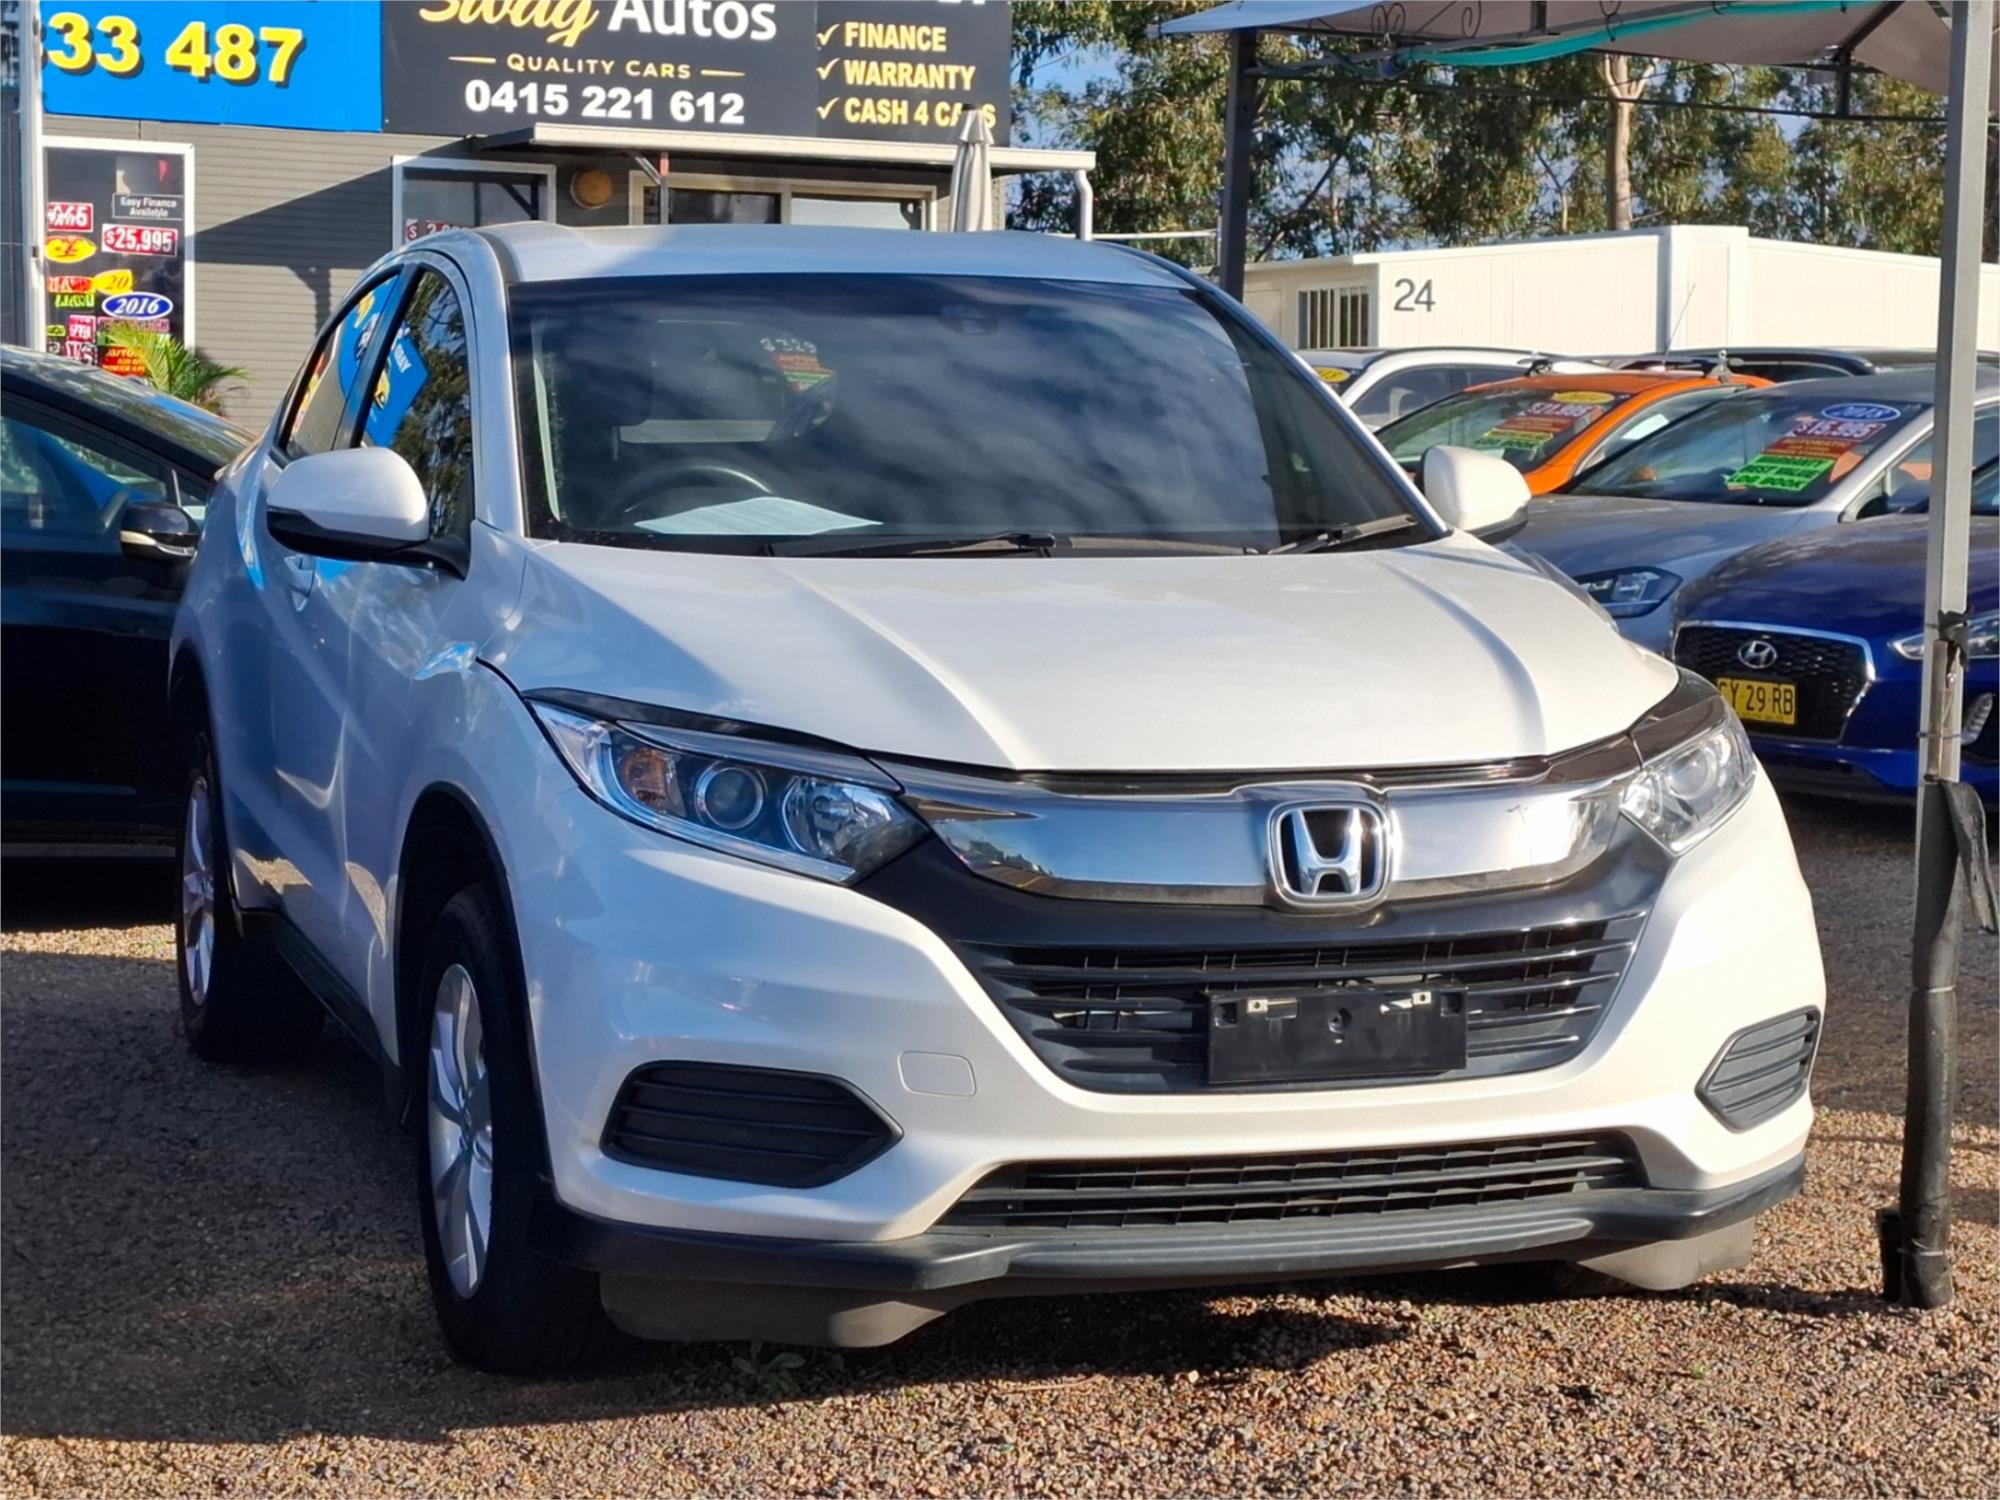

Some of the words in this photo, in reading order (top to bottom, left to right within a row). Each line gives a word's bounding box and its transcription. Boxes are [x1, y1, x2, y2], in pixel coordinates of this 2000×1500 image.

[607, 0, 777, 41] Autos
[165, 21, 303, 82] 487
[844, 21, 947, 52] FINANCE
[507, 53, 615, 75] QUALITY
[626, 60, 691, 79] CARS
[843, 60, 976, 91] WARRANTY
[465, 79, 569, 115] 0415
[581, 85, 653, 120] 221
[669, 90, 745, 124] 612
[844, 97, 909, 125] CASH
[914, 101, 929, 126] 4
[935, 101, 997, 129] CAS
[120, 196, 141, 208] Easy
[143, 196, 177, 208] Finance
[129, 207, 169, 218] Available
[105, 227, 173, 253] $25,995
[114, 297, 161, 315] 2016
[1393, 278, 1437, 312] 24
[1745, 685, 1766, 712] 29
[1772, 687, 1794, 715] RB
